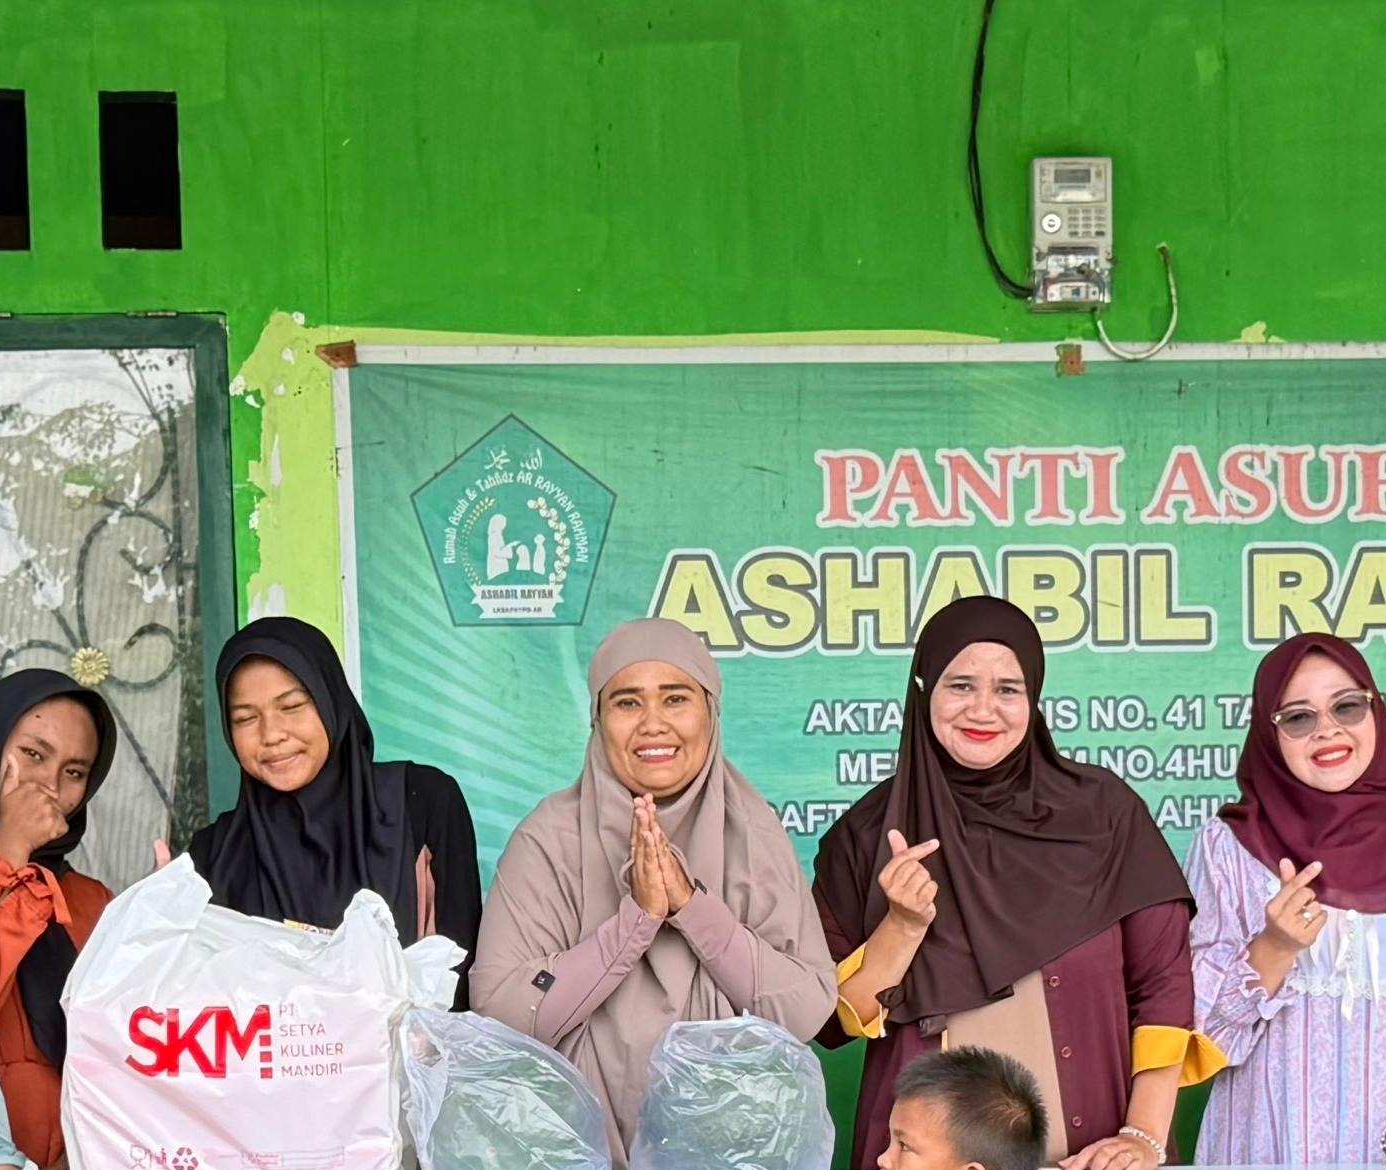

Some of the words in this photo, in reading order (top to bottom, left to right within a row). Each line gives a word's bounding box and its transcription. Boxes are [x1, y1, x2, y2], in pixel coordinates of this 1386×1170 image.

[816, 447, 1127, 527] PANTI
[516, 470, 533, 486] AR
[534, 476, 575, 512] RAYYAN
[567, 511, 589, 564] RAHMAN
[804, 699, 904, 733] AKTA
[1088, 697, 1154, 730] NO.
[1164, 696, 1203, 729] 41
[125, 1004, 273, 1079] SKM
[279, 1023, 326, 1037] SETYA
[280, 1042, 344, 1058] KULINER
[281, 1062, 343, 1077] MANDIRI
